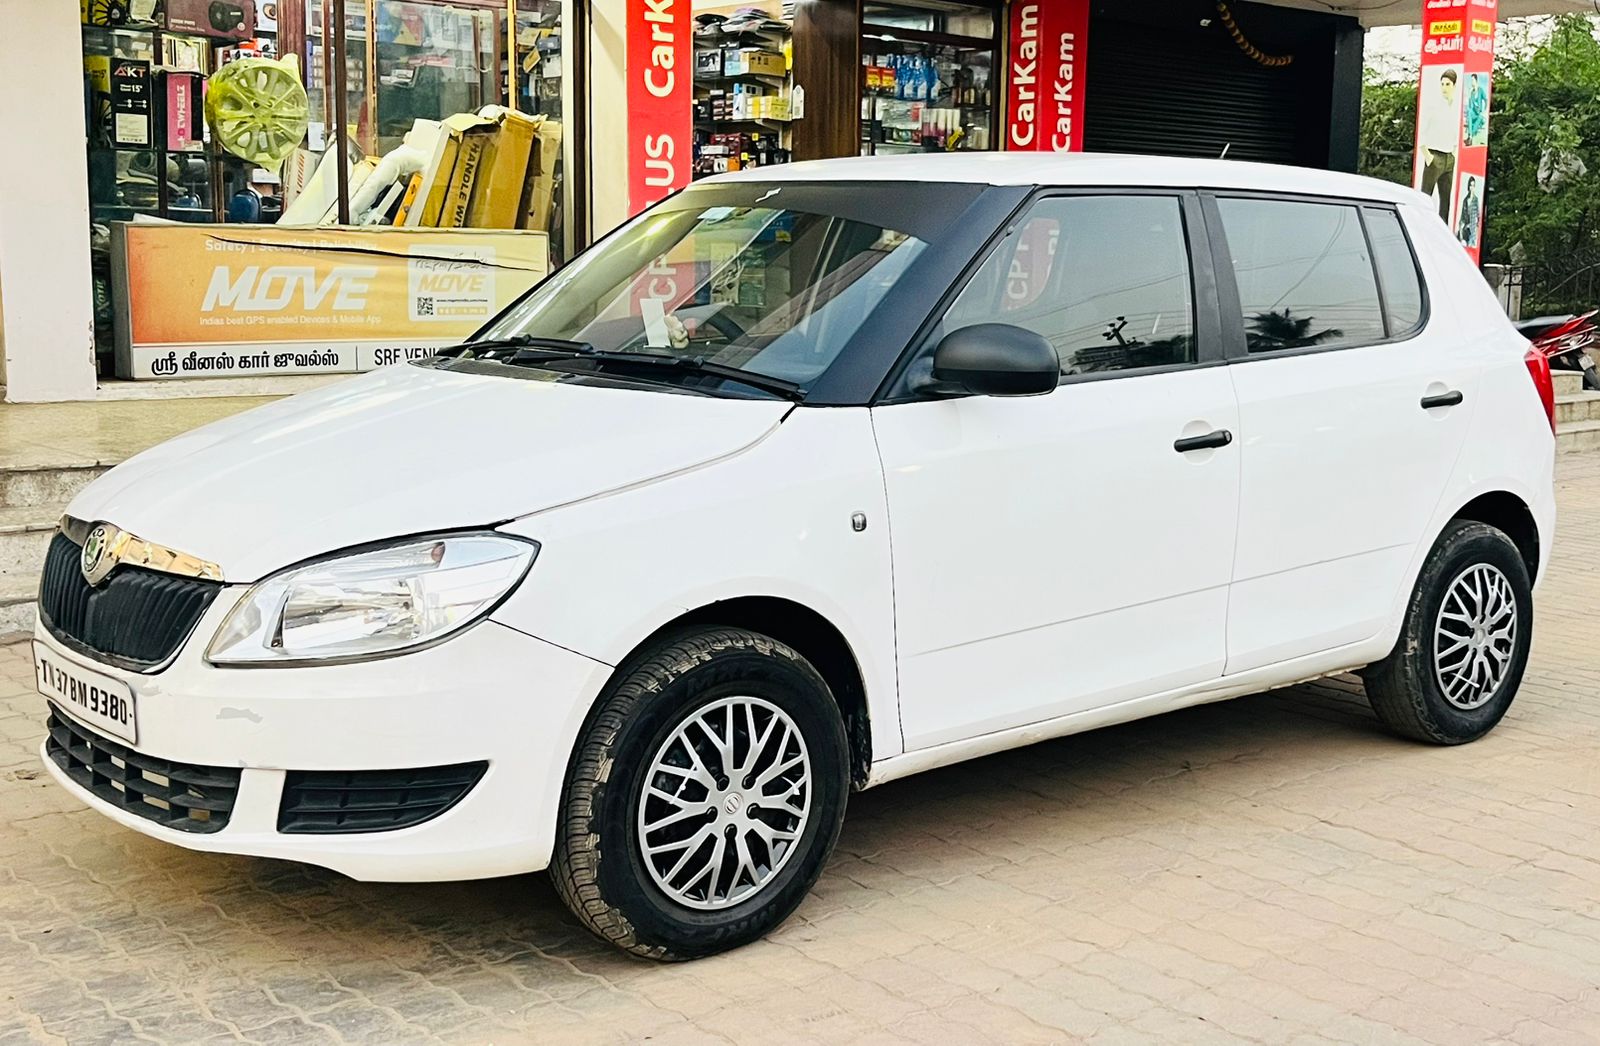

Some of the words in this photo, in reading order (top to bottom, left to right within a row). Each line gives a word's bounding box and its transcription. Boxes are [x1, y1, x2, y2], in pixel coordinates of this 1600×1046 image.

[1011, 4, 1039, 147] CarKam
[1051, 32, 1075, 153] CarKam
[458, 144, 480, 202] HANDLE
[201, 265, 379, 312] MOVE
[417, 273, 488, 293] MOVE
[246, 315, 265, 325] GPS
[182, 351, 234, 370] வீனஸ்
[238, 350, 270, 368] கார்
